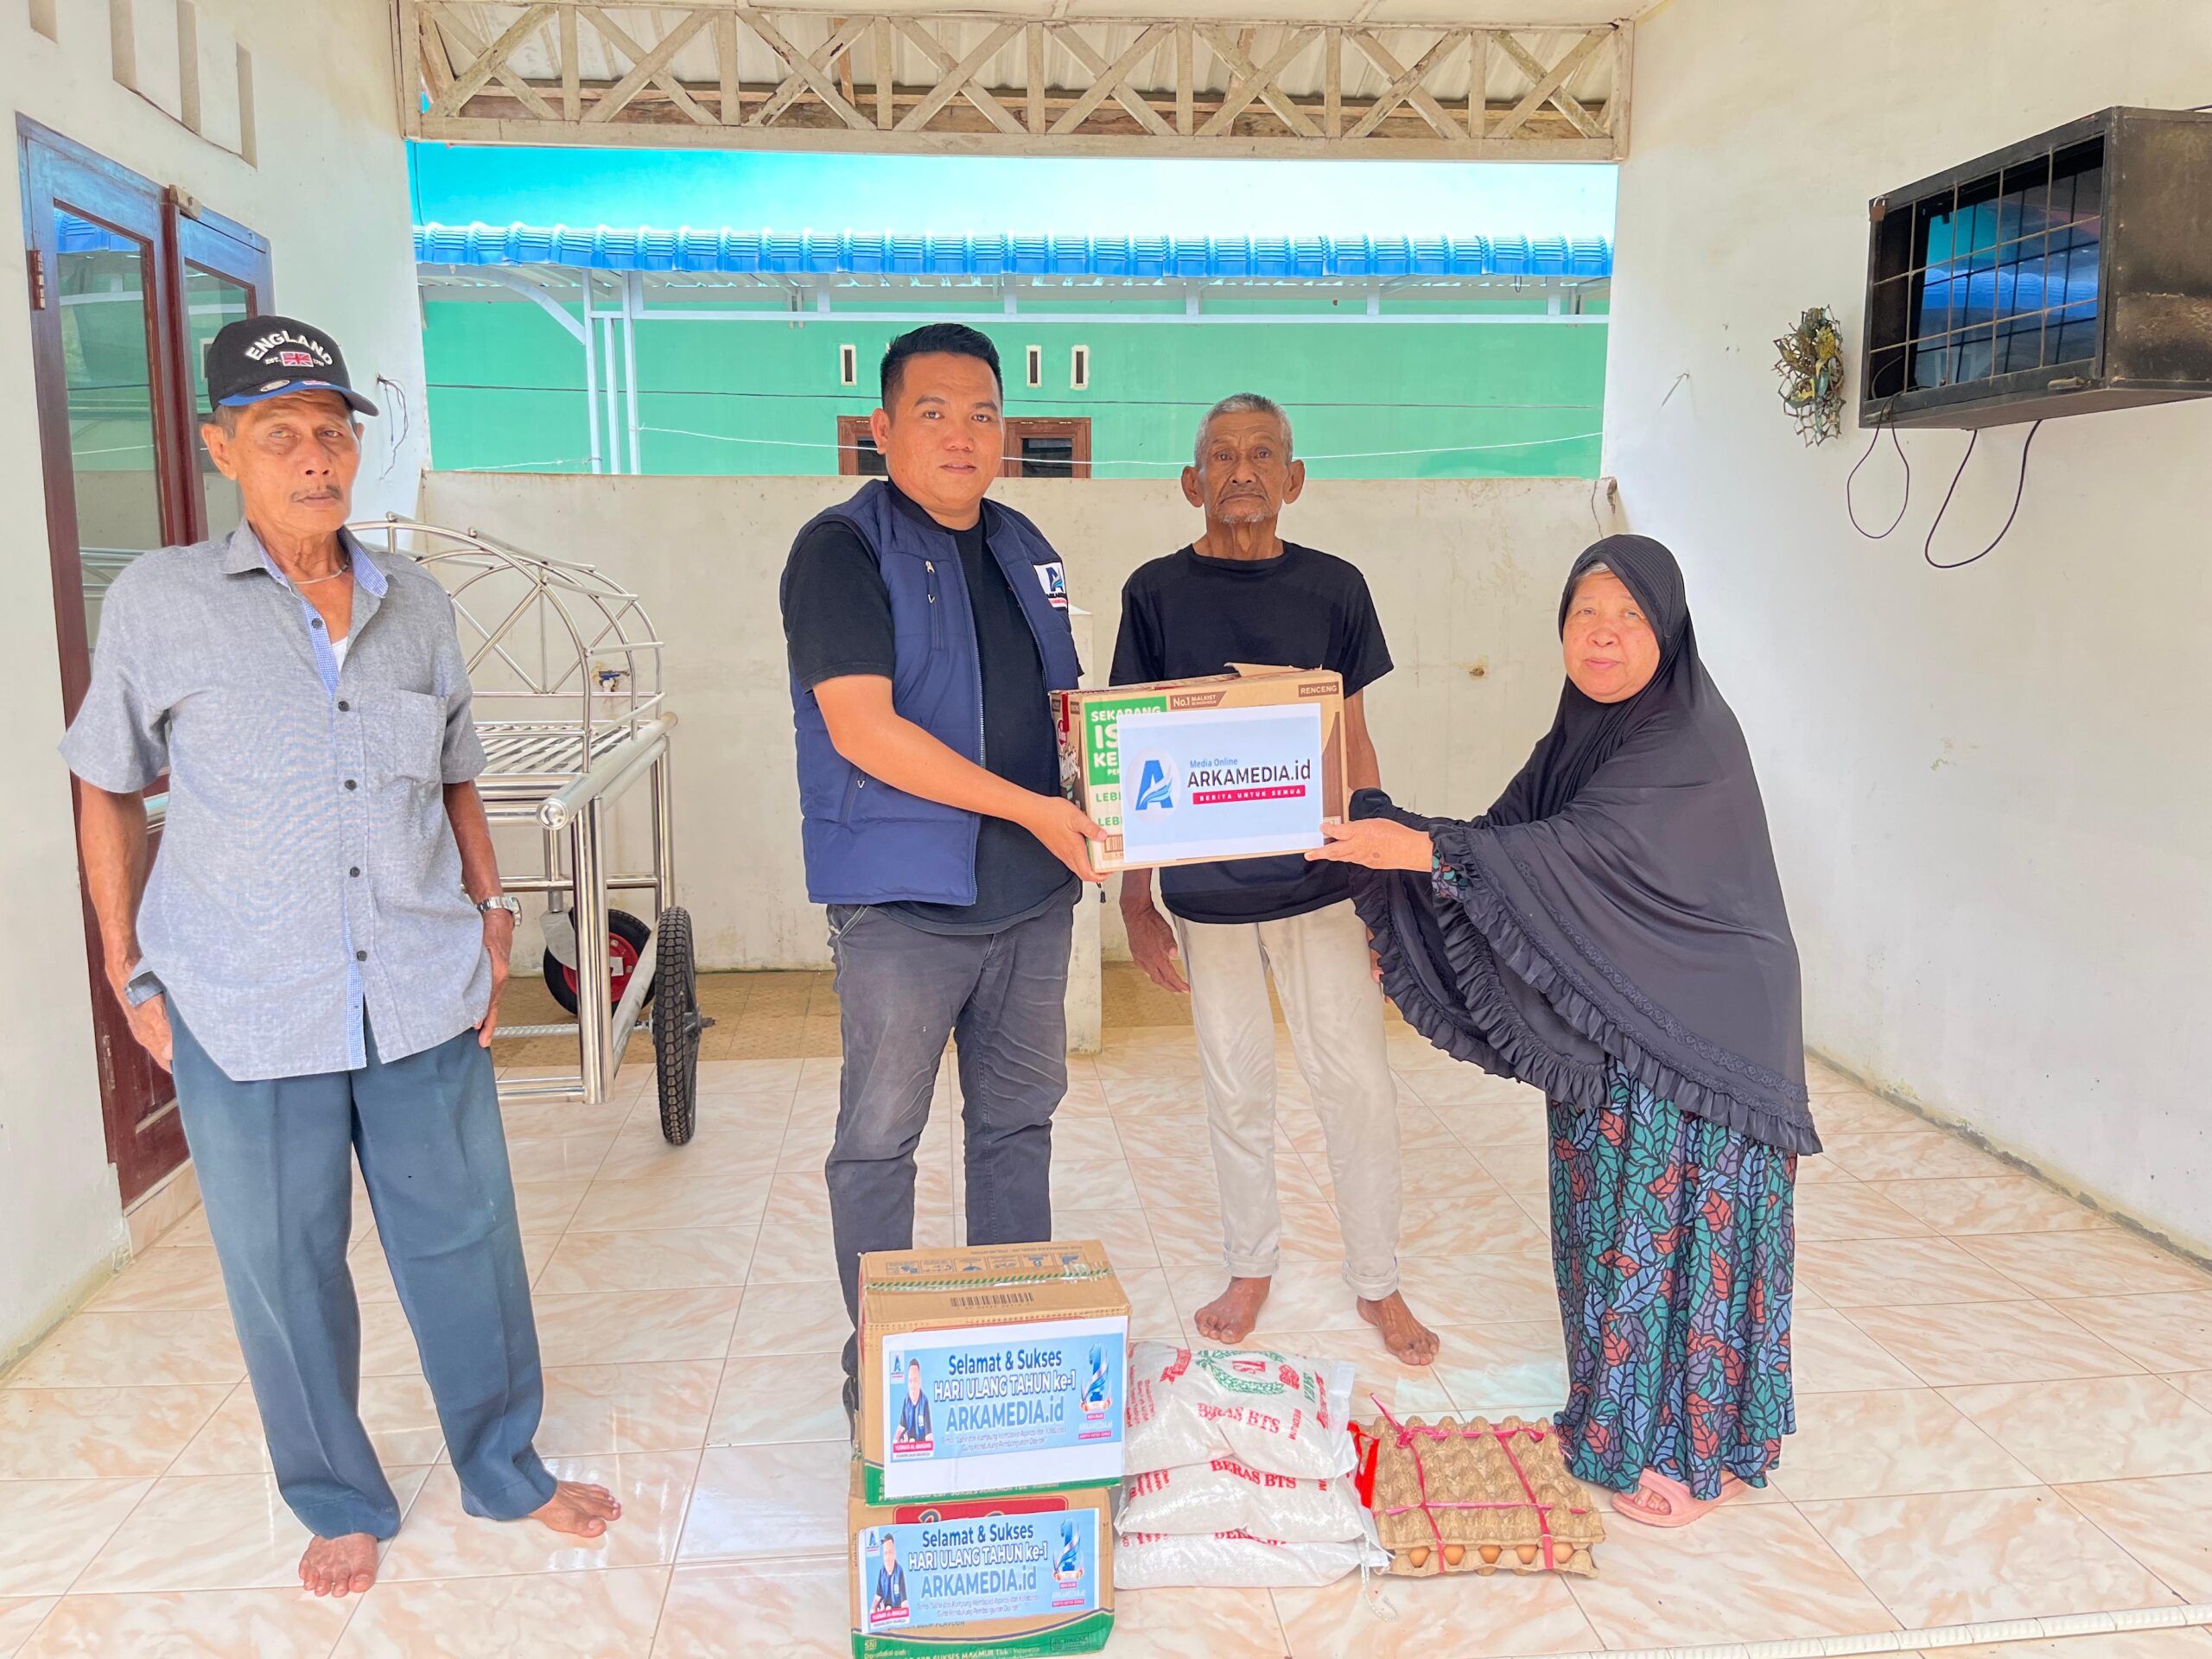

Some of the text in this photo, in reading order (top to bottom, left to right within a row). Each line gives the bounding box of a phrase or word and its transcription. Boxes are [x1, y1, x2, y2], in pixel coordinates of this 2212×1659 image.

[245, 330, 334, 365] ENGLAND
[1173, 696, 1190, 707] No.1
[1300, 684, 1338, 695] RENCENG
[1187, 759, 1311, 788] ARKAMEDIA.id
[1190, 757, 1238, 768] Media Online
[1199, 793, 1232, 802] BERITA
[949, 1348, 1062, 1376] Selamat & Sukses
[934, 1369, 1077, 1402] HARI ULANG TAHUN ke-1
[946, 1395, 1064, 1433] ARKAMEDIA.id
[1247, 1409, 1281, 1434] BTS
[1211, 1459, 1261, 1484] BERAS
[1264, 1472, 1297, 1489] BTS
[922, 1522, 1034, 1548] Selamat & Sukses
[909, 1541, 1048, 1571] HARI ULANG TAHUN ke-1
[921, 1565, 1037, 1599] ARKAMEDIA.id
